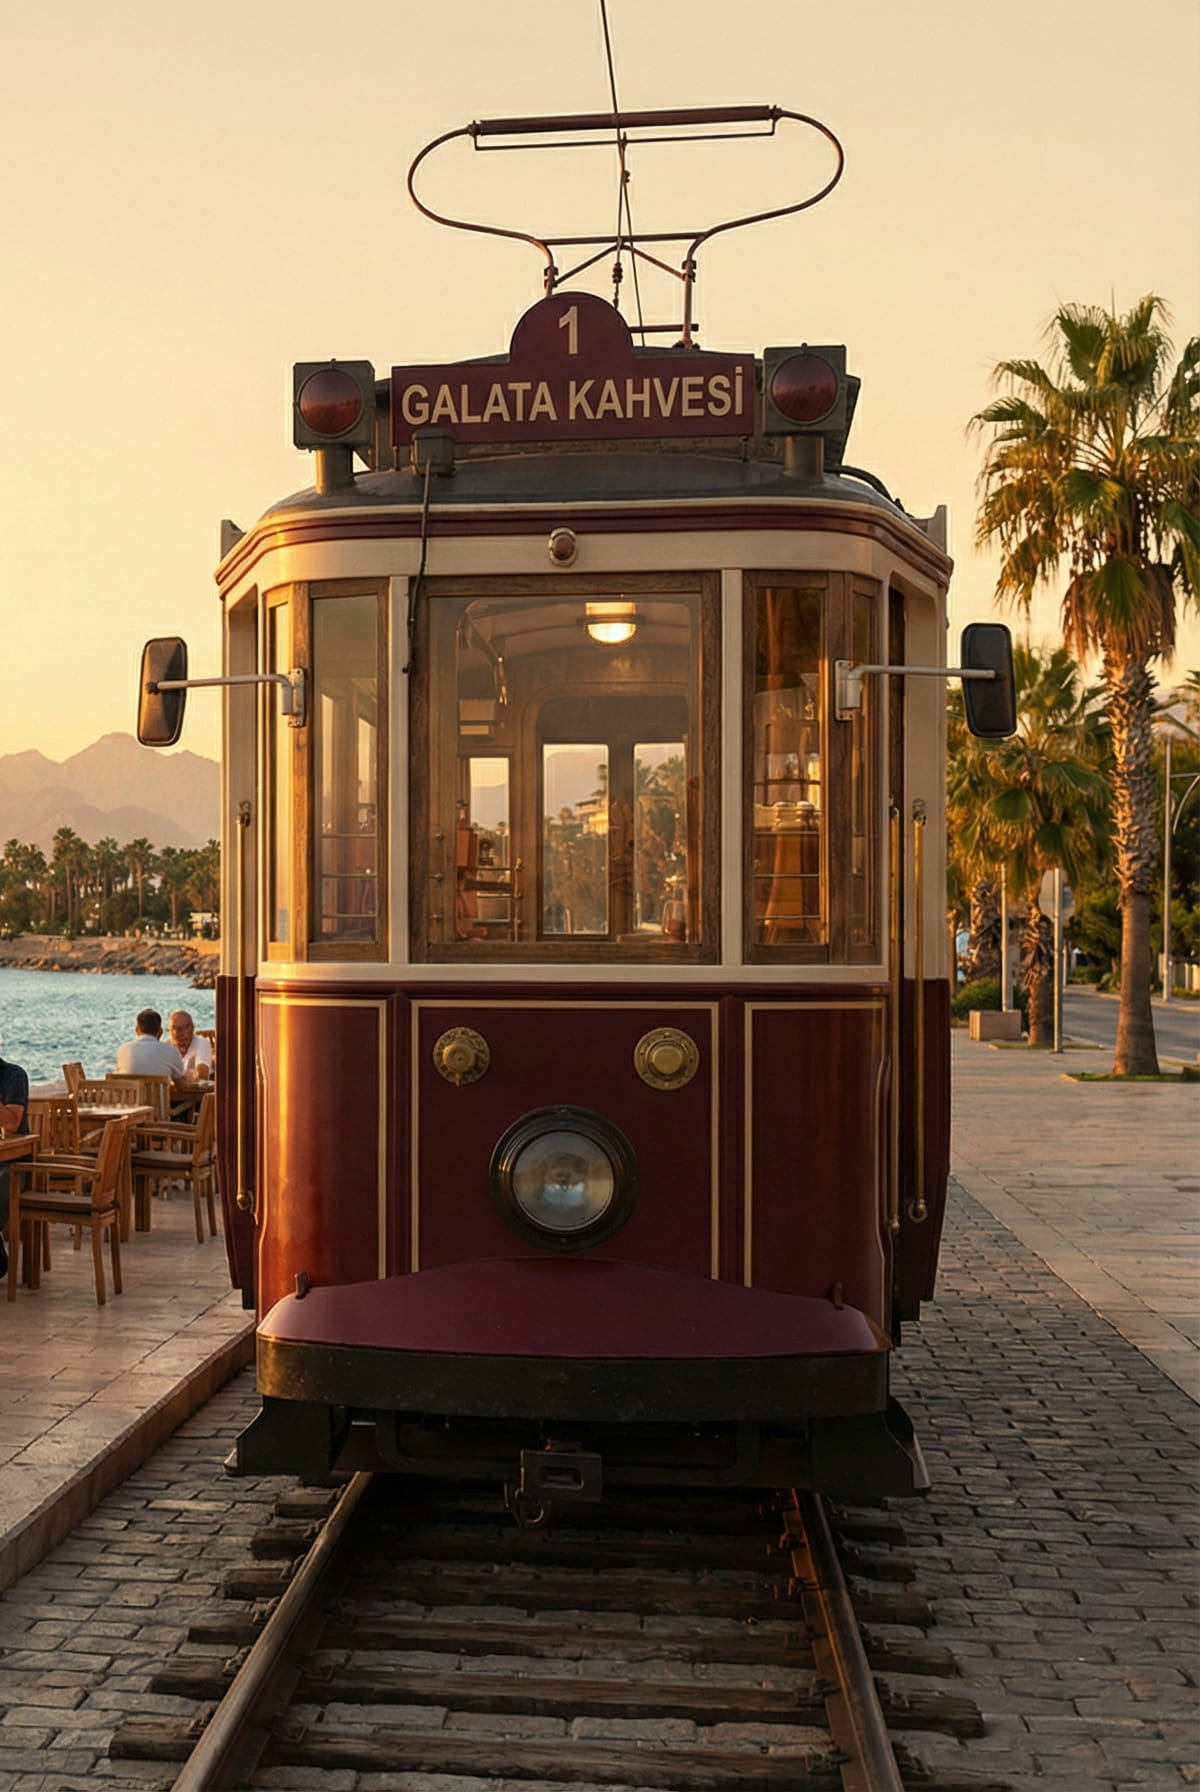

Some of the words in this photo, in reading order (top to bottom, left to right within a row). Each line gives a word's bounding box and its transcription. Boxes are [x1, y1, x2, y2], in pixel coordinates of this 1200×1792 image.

[558, 306, 578, 354] 1
[402, 382, 558, 425] GALATA
[569, 367, 743, 420] KAHVESİ
